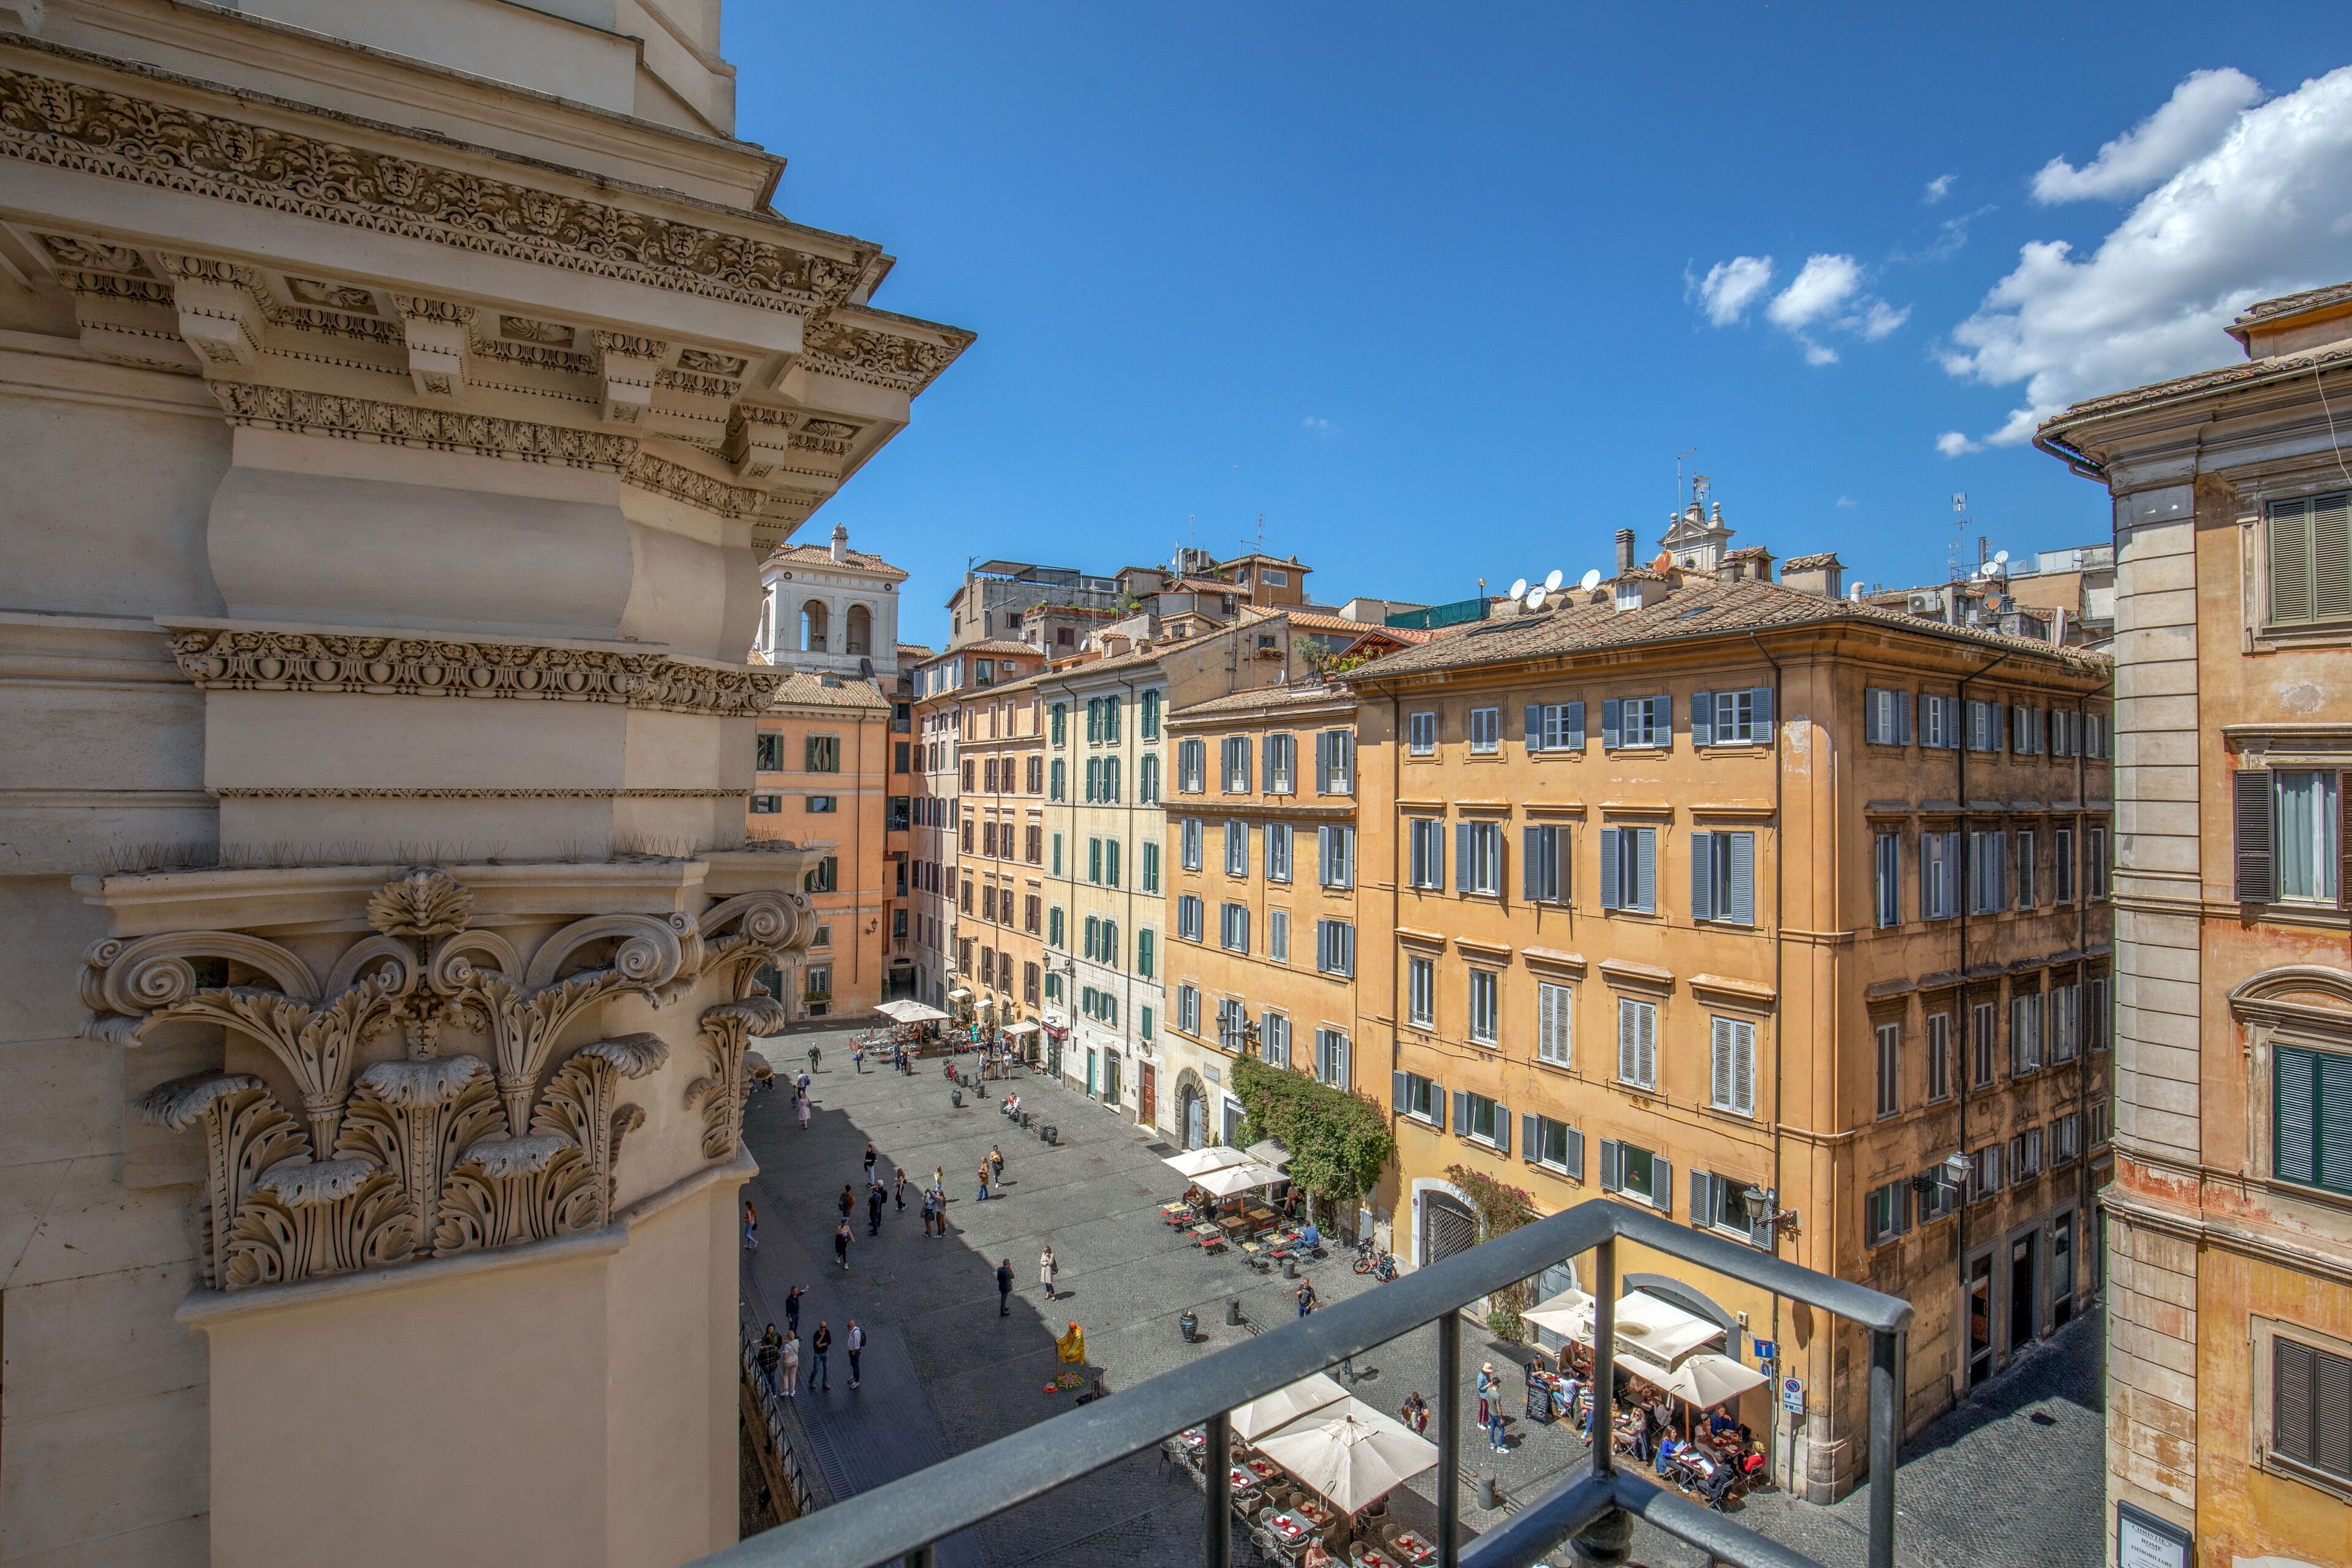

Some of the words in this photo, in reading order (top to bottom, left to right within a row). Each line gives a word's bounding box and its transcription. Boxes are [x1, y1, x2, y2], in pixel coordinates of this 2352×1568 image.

[801, 573, 877, 589] FERRINA
[2132, 1525, 2173, 1547] CHRISTIE'S
[2141, 1537, 2162, 1551] ROME
[2132, 1544, 2173, 1568] IMMOBILIARE
